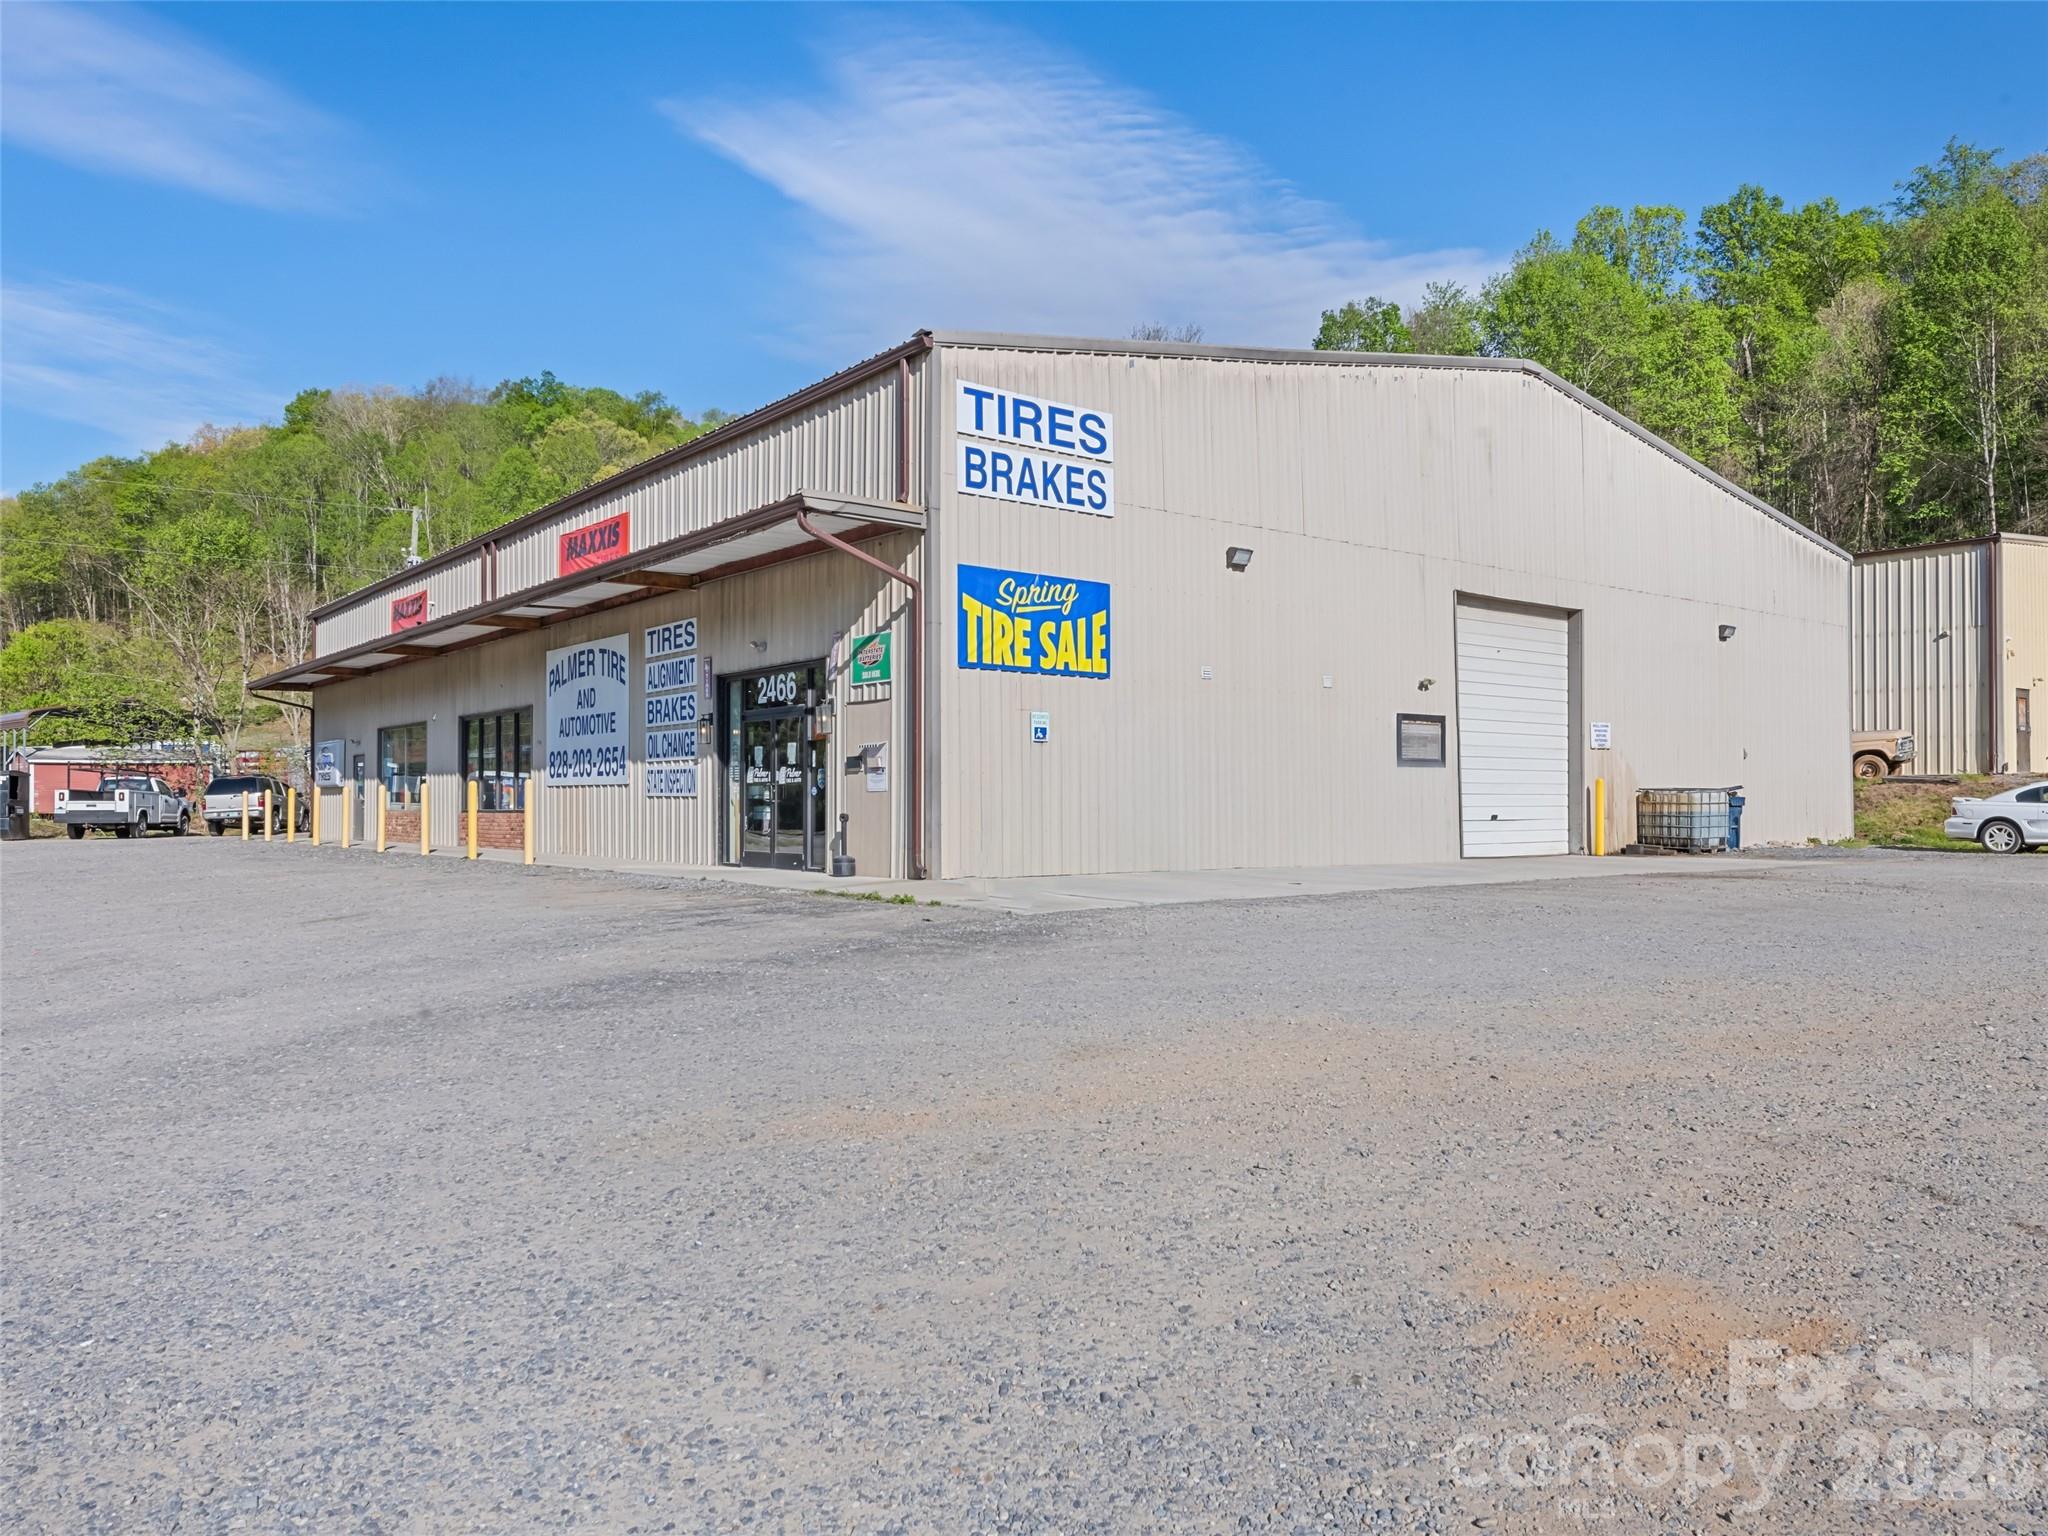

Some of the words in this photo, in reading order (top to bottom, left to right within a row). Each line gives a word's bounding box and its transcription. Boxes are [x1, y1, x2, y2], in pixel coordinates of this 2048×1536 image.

[963, 386, 1107, 455] TIRES
[965, 446, 1107, 510] BRAKES
[566, 521, 620, 561] MAXXIS
[995, 577, 1079, 616] Spring
[647, 621, 695, 654] TIRES
[962, 592, 1032, 668] TIRE
[1039, 609, 1107, 674] SALE
[549, 649, 596, 697] PALMER
[599, 649, 626, 685] TIRE
[647, 658, 695, 689] ALIGNMENT
[757, 672, 797, 704] 2466
[577, 688, 596, 709] AND
[648, 694, 695, 724] BRAKES
[559, 712, 616, 738] AUTOMOTIVE
[648, 735, 660, 759] OIL
[662, 731, 695, 758] CHANGE
[549, 745, 626, 779] 828-203-2654
[647, 769, 663, 793] STATE
[664, 768, 695, 794] INSPECTION
